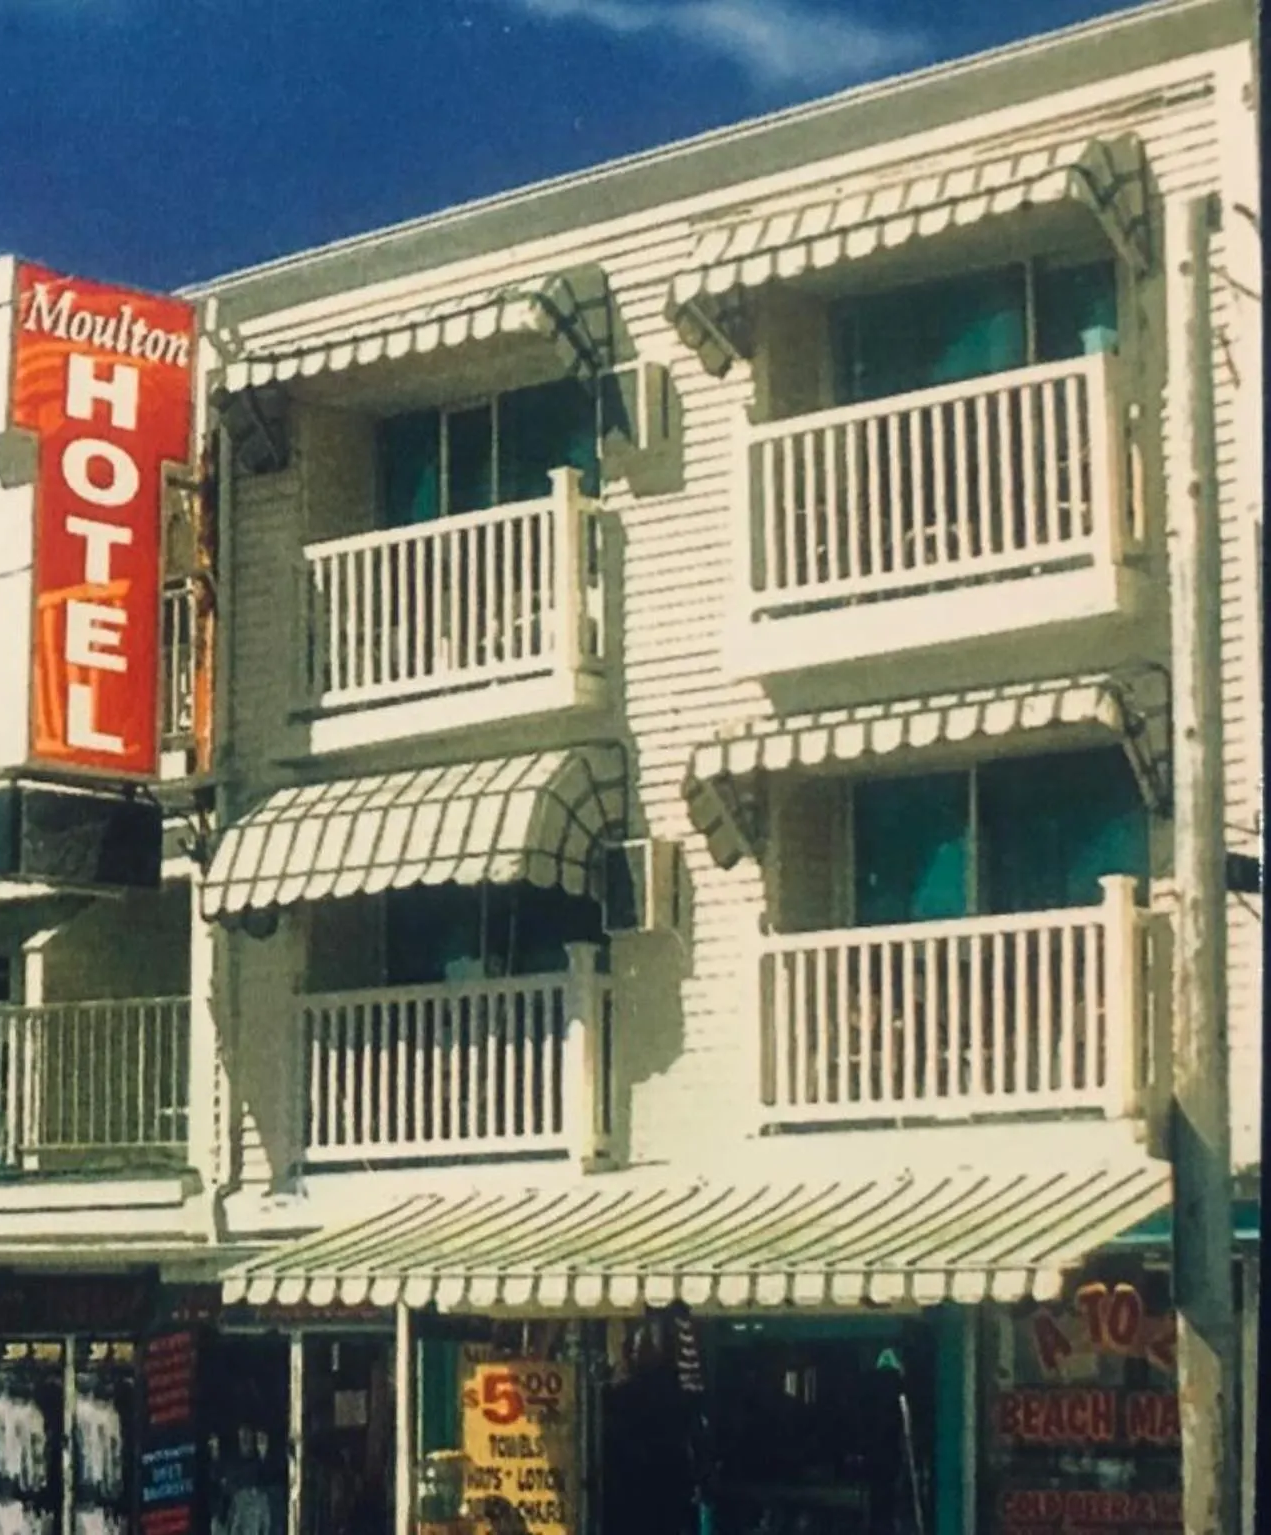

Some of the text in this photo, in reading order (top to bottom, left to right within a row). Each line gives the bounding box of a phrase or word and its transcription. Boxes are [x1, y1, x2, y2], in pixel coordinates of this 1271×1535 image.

[24, 282, 190, 368] Moulton
[61, 352, 140, 754] HOTEL
[1075, 1283, 1142, 1350] TO
[997, 1387, 1116, 1440] BEACH
